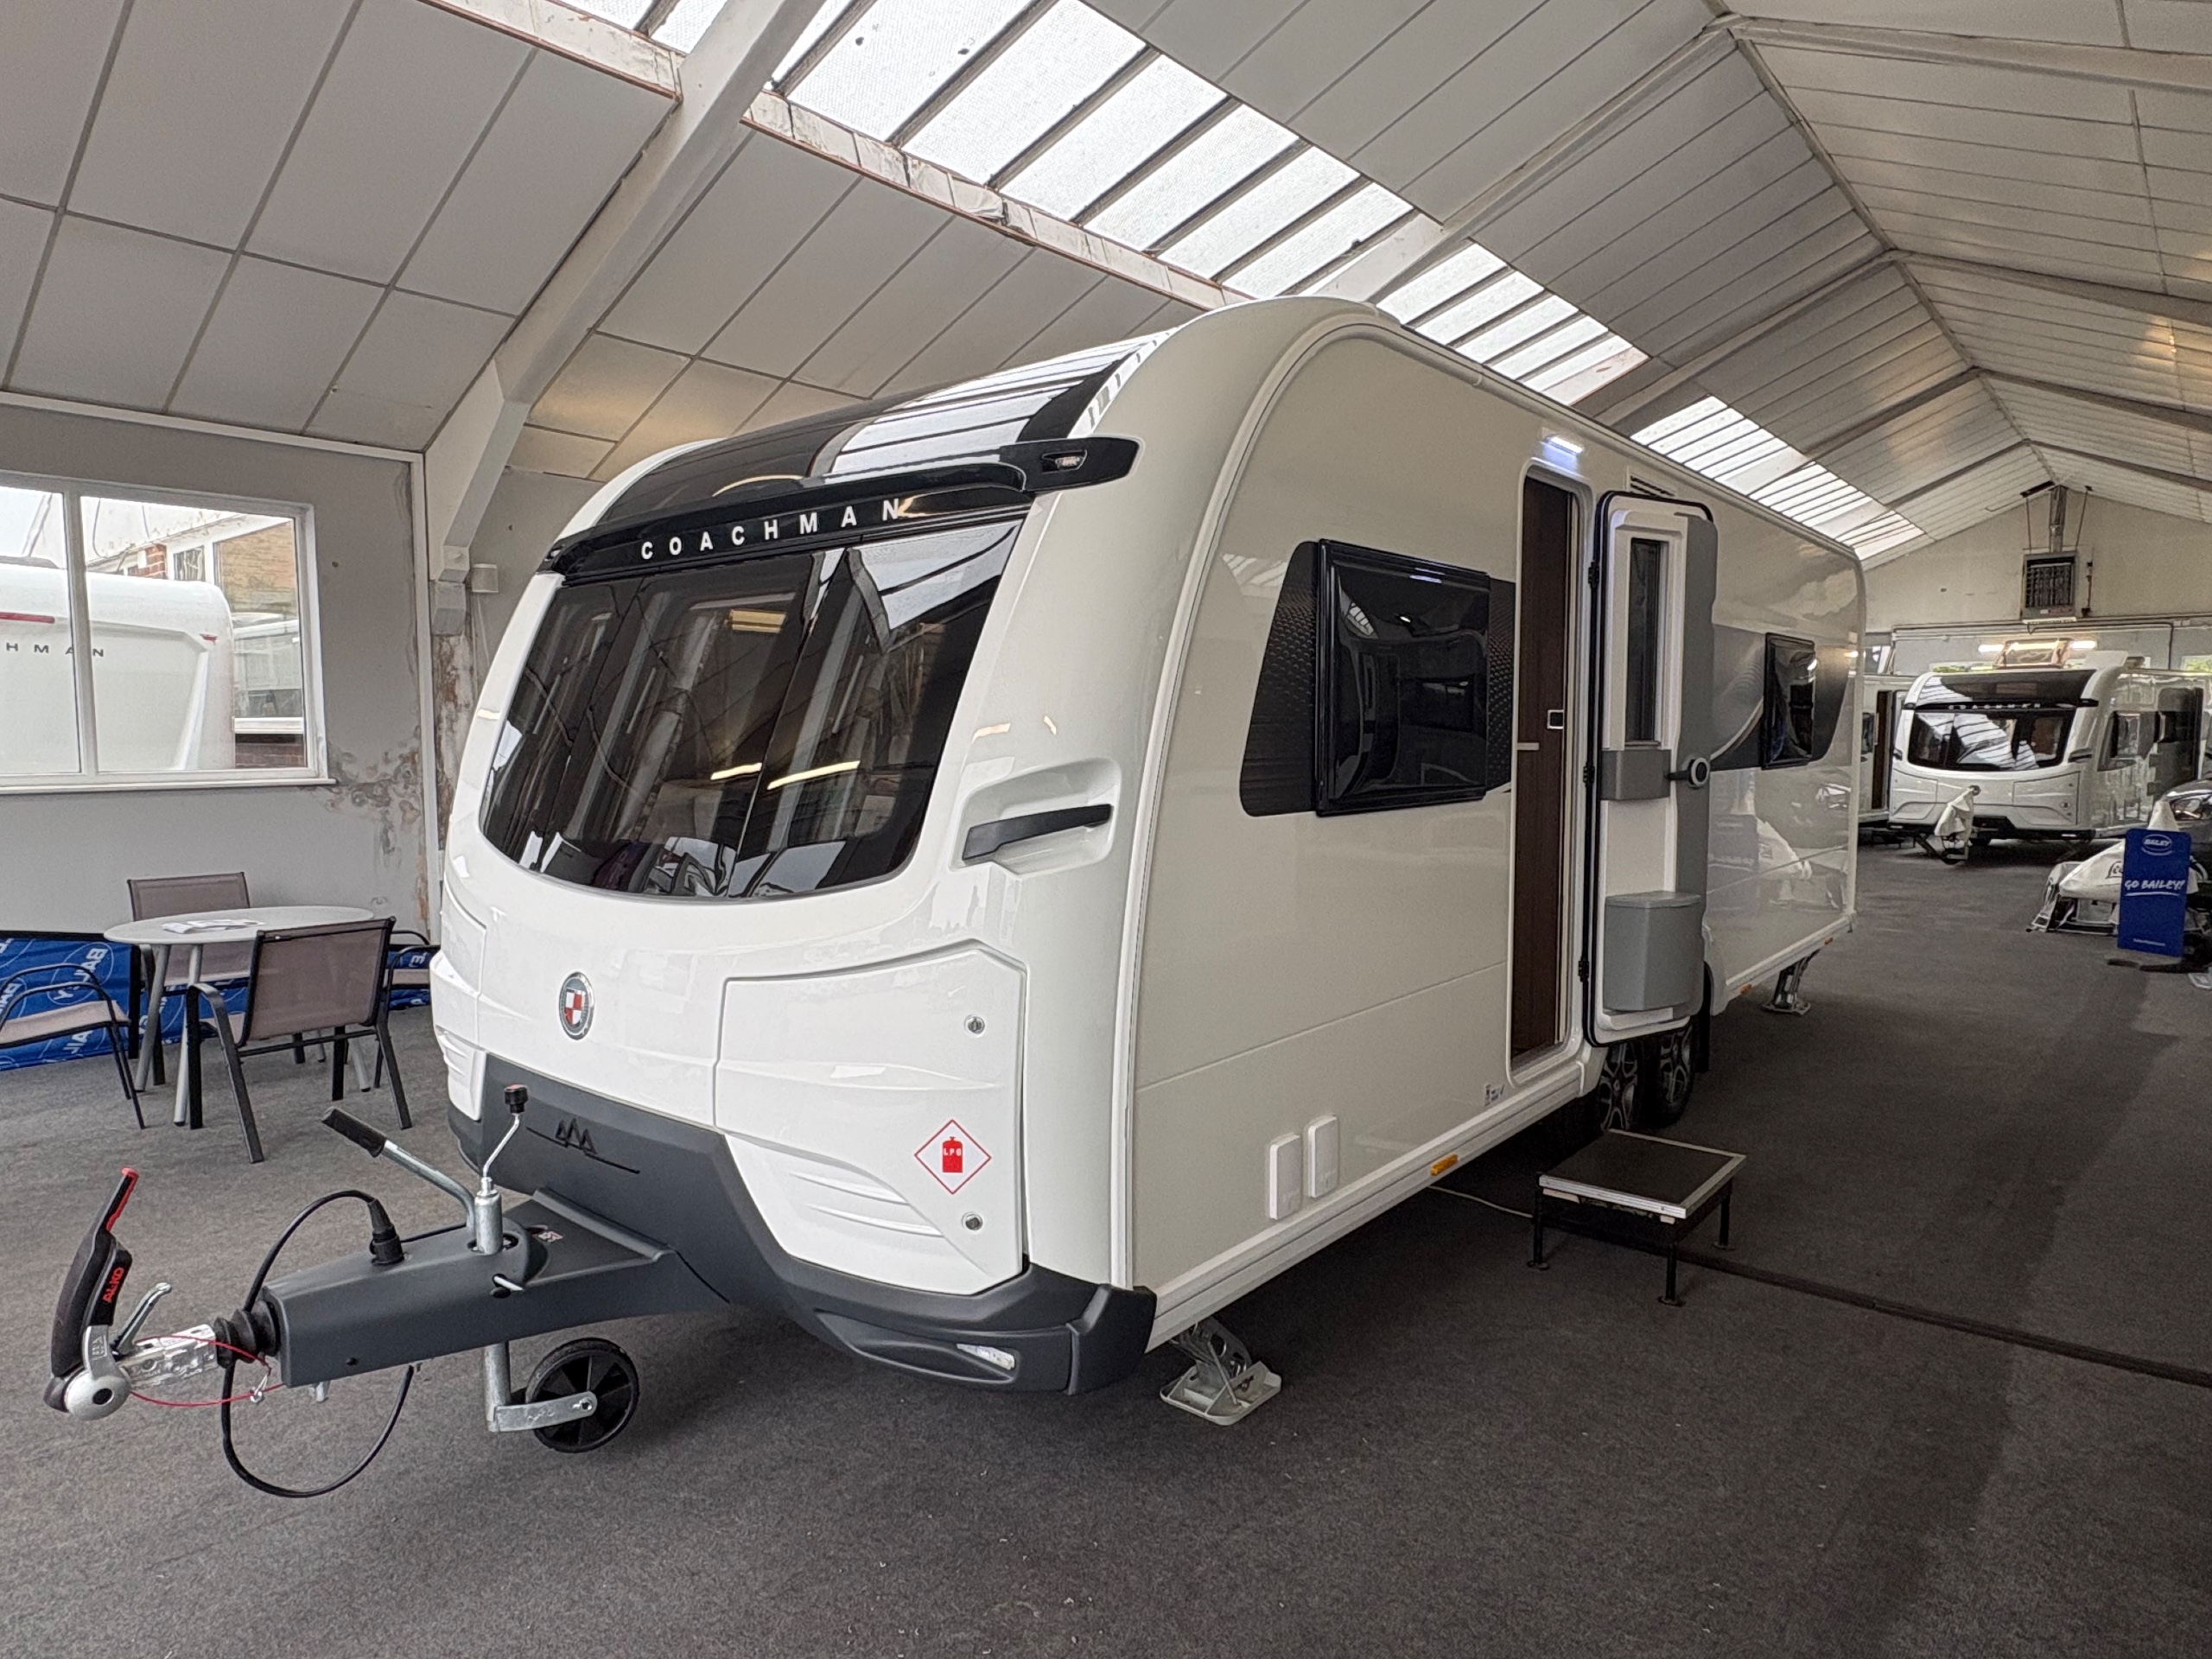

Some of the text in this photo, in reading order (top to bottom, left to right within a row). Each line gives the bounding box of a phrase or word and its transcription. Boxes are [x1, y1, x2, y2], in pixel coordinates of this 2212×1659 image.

[640, 498, 900, 560] COACHMAN
[2125, 880, 2186, 891] GO BAILEY!
[943, 1147, 963, 1157] LPG
